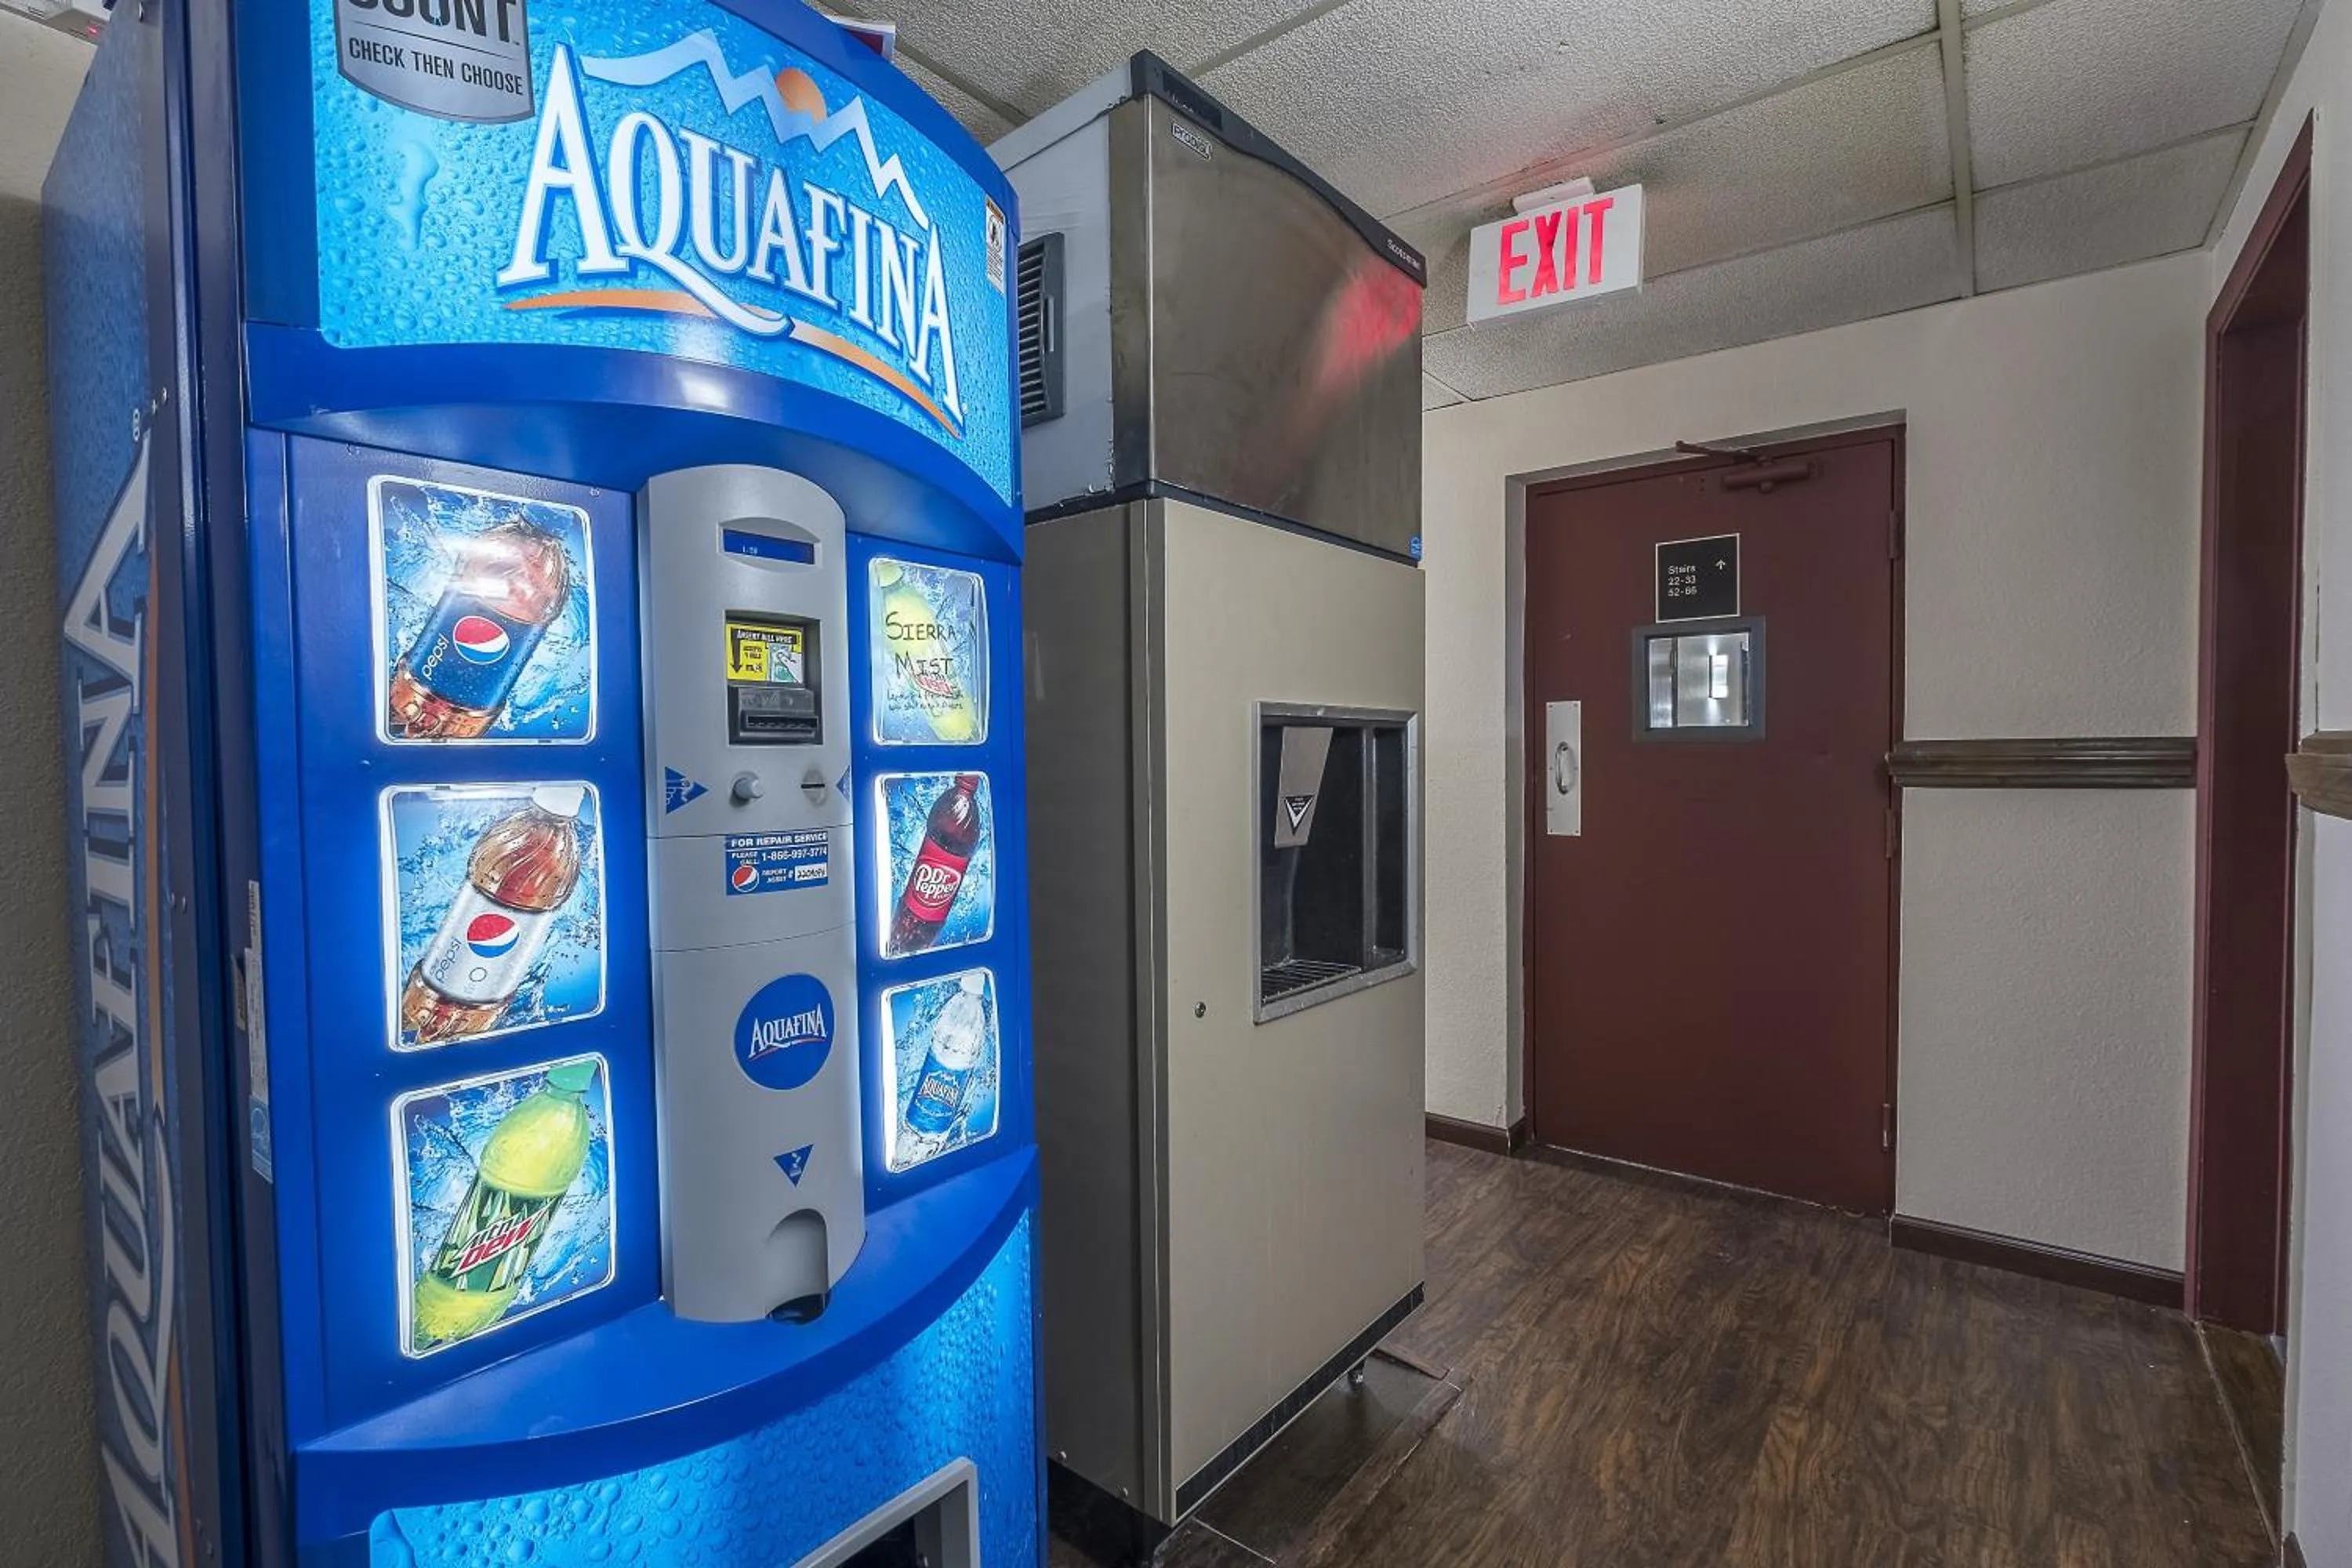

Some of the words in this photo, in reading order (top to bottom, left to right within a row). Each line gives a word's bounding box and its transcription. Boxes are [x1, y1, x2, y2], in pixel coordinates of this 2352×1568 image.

[347, 0, 517, 42] UNT
[349, 37, 405, 69] CHECK
[411, 50, 455, 79] THEN
[461, 63, 524, 96] CHOOSE
[496, 42, 965, 424] AQUAFINA
[1497, 197, 1615, 306] EXIT
[1668, 564, 1696, 575] Stairs
[885, 611, 958, 642] SIERRA
[422, 633, 449, 681] pepsi
[895, 650, 954, 679] MIST
[731, 838, 753, 848] FOR
[757, 835, 793, 846] REPAIR
[794, 832, 827, 843] SERVICE
[731, 851, 758, 859] PLEASE
[916, 864, 956, 899] Pepper
[929, 867, 951, 884] Dr
[434, 937, 463, 983] pepsi
[748, 1003, 827, 1059] AQUAFINA
